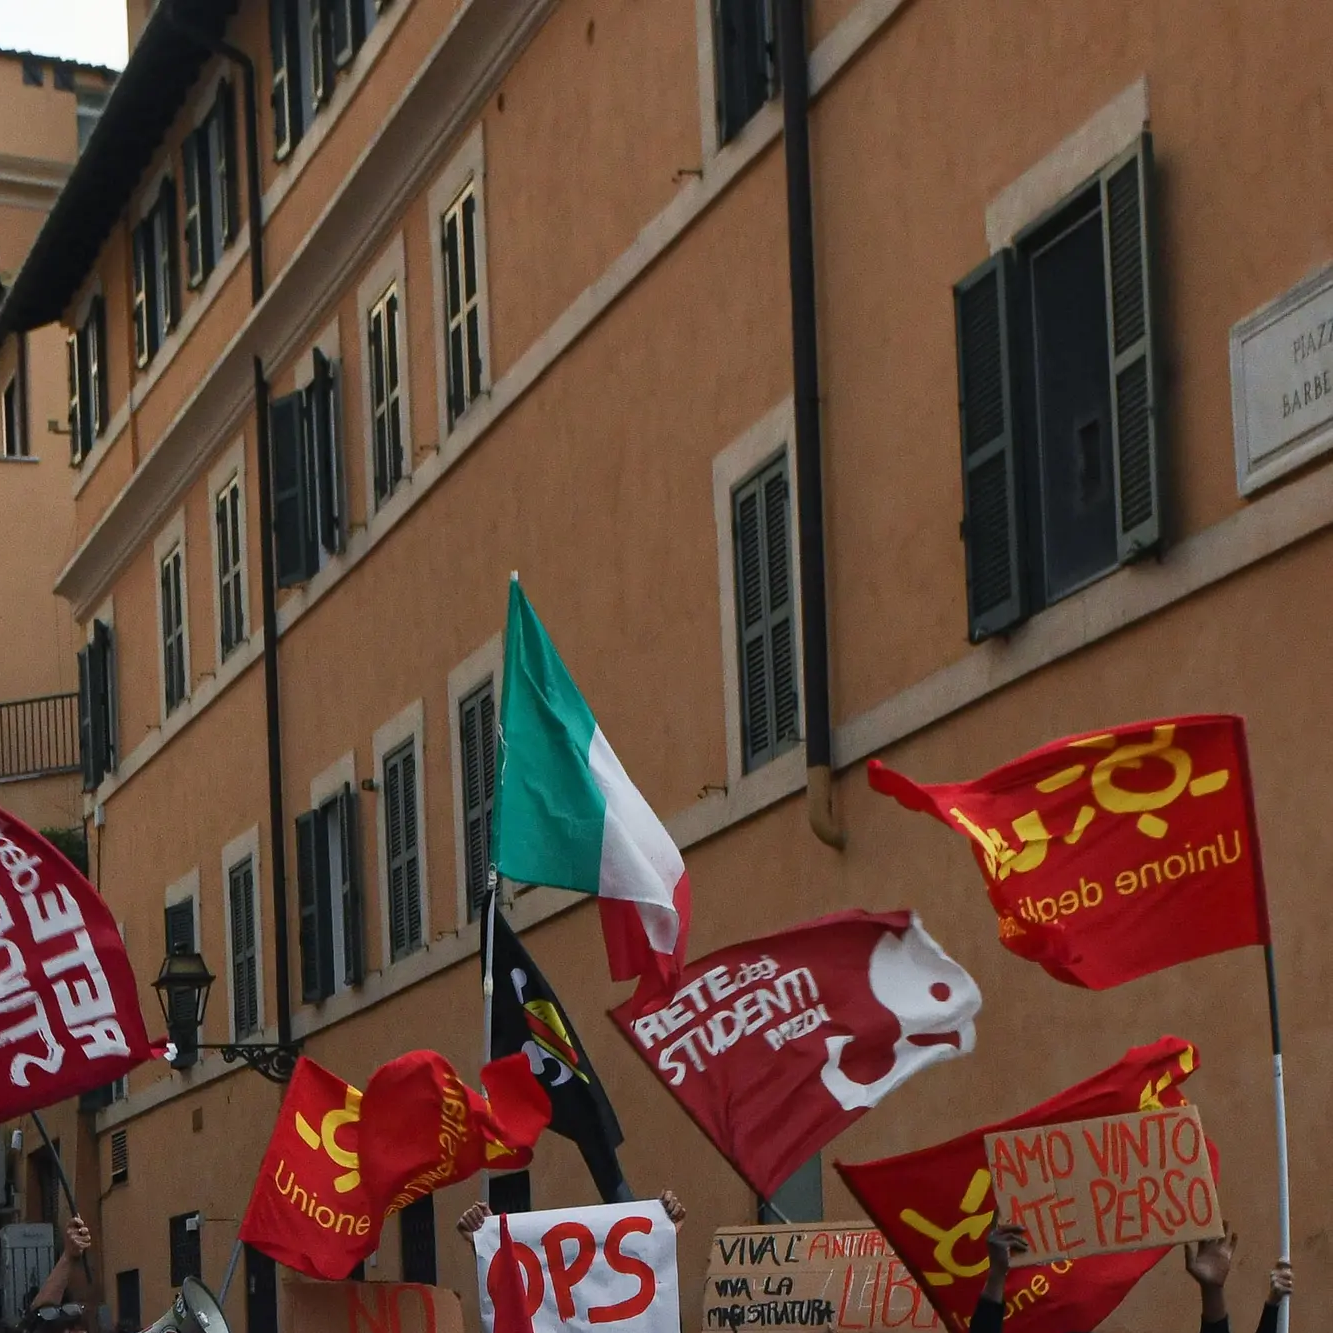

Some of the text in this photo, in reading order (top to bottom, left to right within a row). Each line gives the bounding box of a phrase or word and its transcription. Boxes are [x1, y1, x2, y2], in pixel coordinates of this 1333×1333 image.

[630, 965, 737, 1049] RETE
[658, 967, 819, 1086] STUDENTI
[763, 1003, 831, 1051] MEDI
[991, 1112, 1201, 1192] AMO VINTO
[275, 1160, 371, 1236] Unione
[1089, 1169, 1213, 1248] PERSO
[715, 1276, 794, 1301] VIVA LA
[717, 1234, 781, 1267] VIVA
